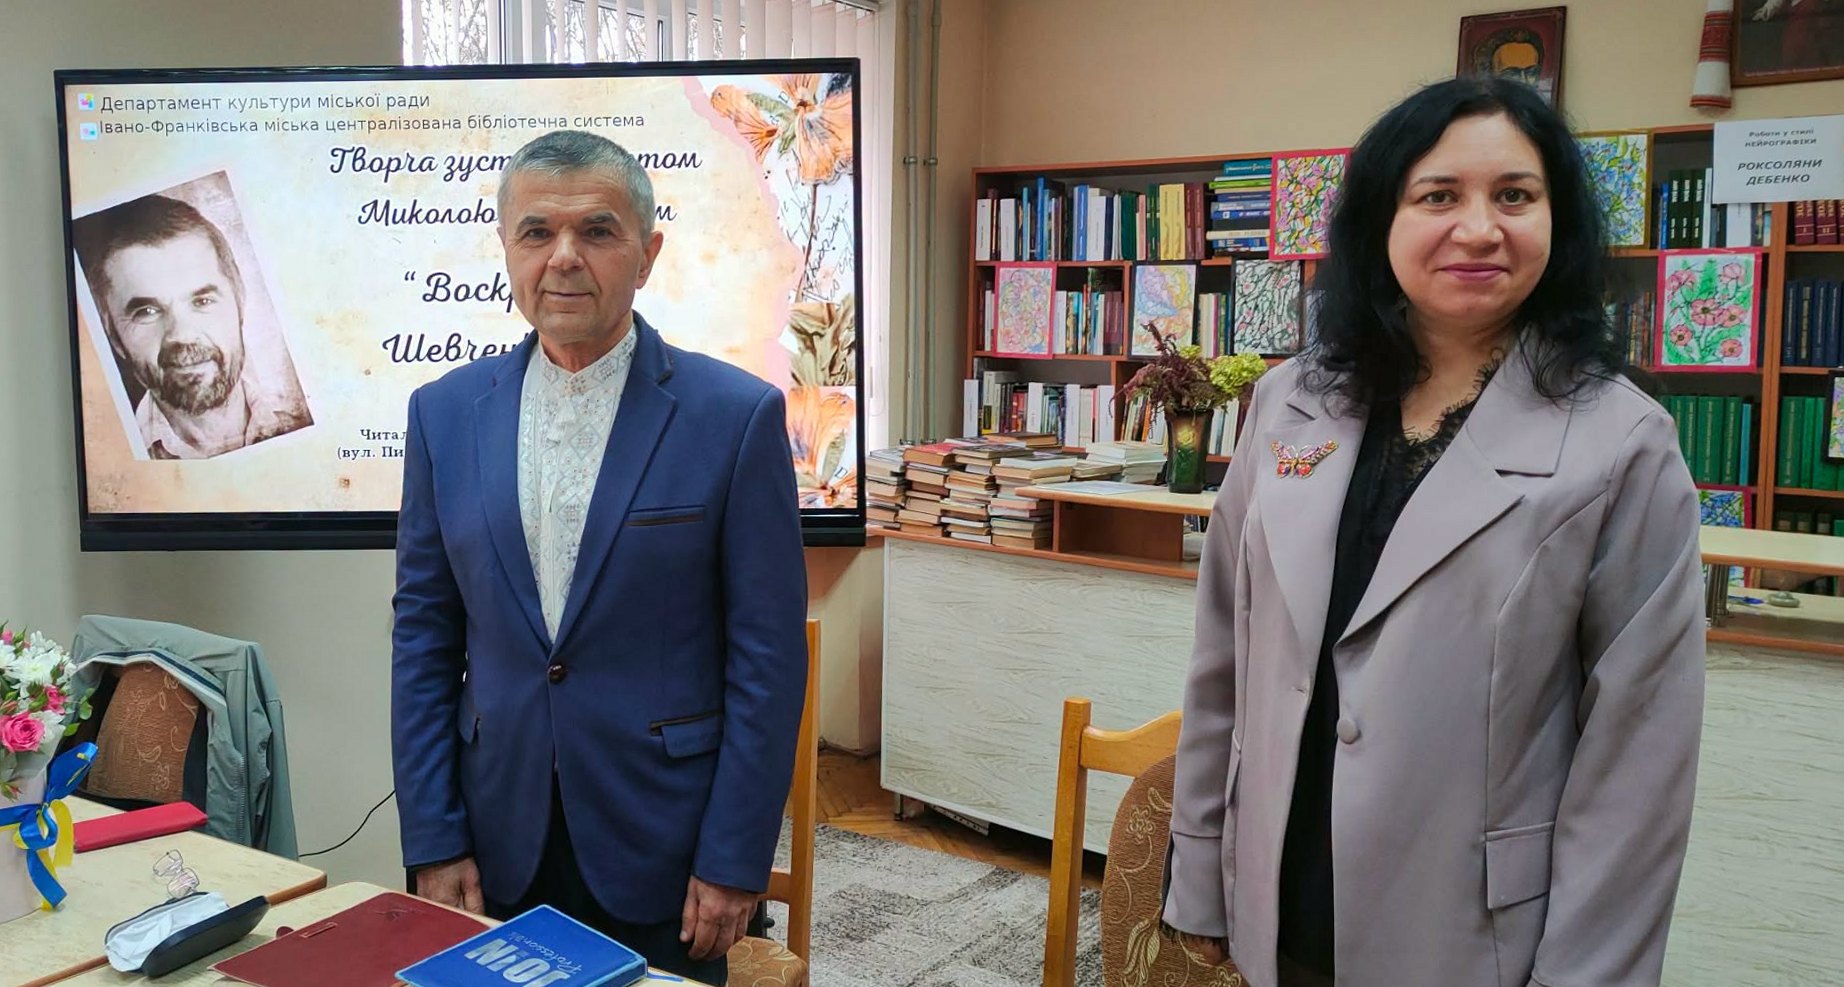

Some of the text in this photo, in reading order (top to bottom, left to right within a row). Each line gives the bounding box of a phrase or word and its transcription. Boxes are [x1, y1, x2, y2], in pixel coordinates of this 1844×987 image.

[100, 94, 430, 114] Департамент культури міської ради
[99, 114, 645, 136] Івано-Франківська міська централізована бібліотечна система
[329, 146, 703, 184] Творча зуст том
[1737, 159, 1823, 171] РОКСОЛЯНИ
[1746, 174, 1811, 186] ДЕБЕНКО
[357, 198, 499, 227] Миколою
[337, 446, 404, 460] (вул. Пи
